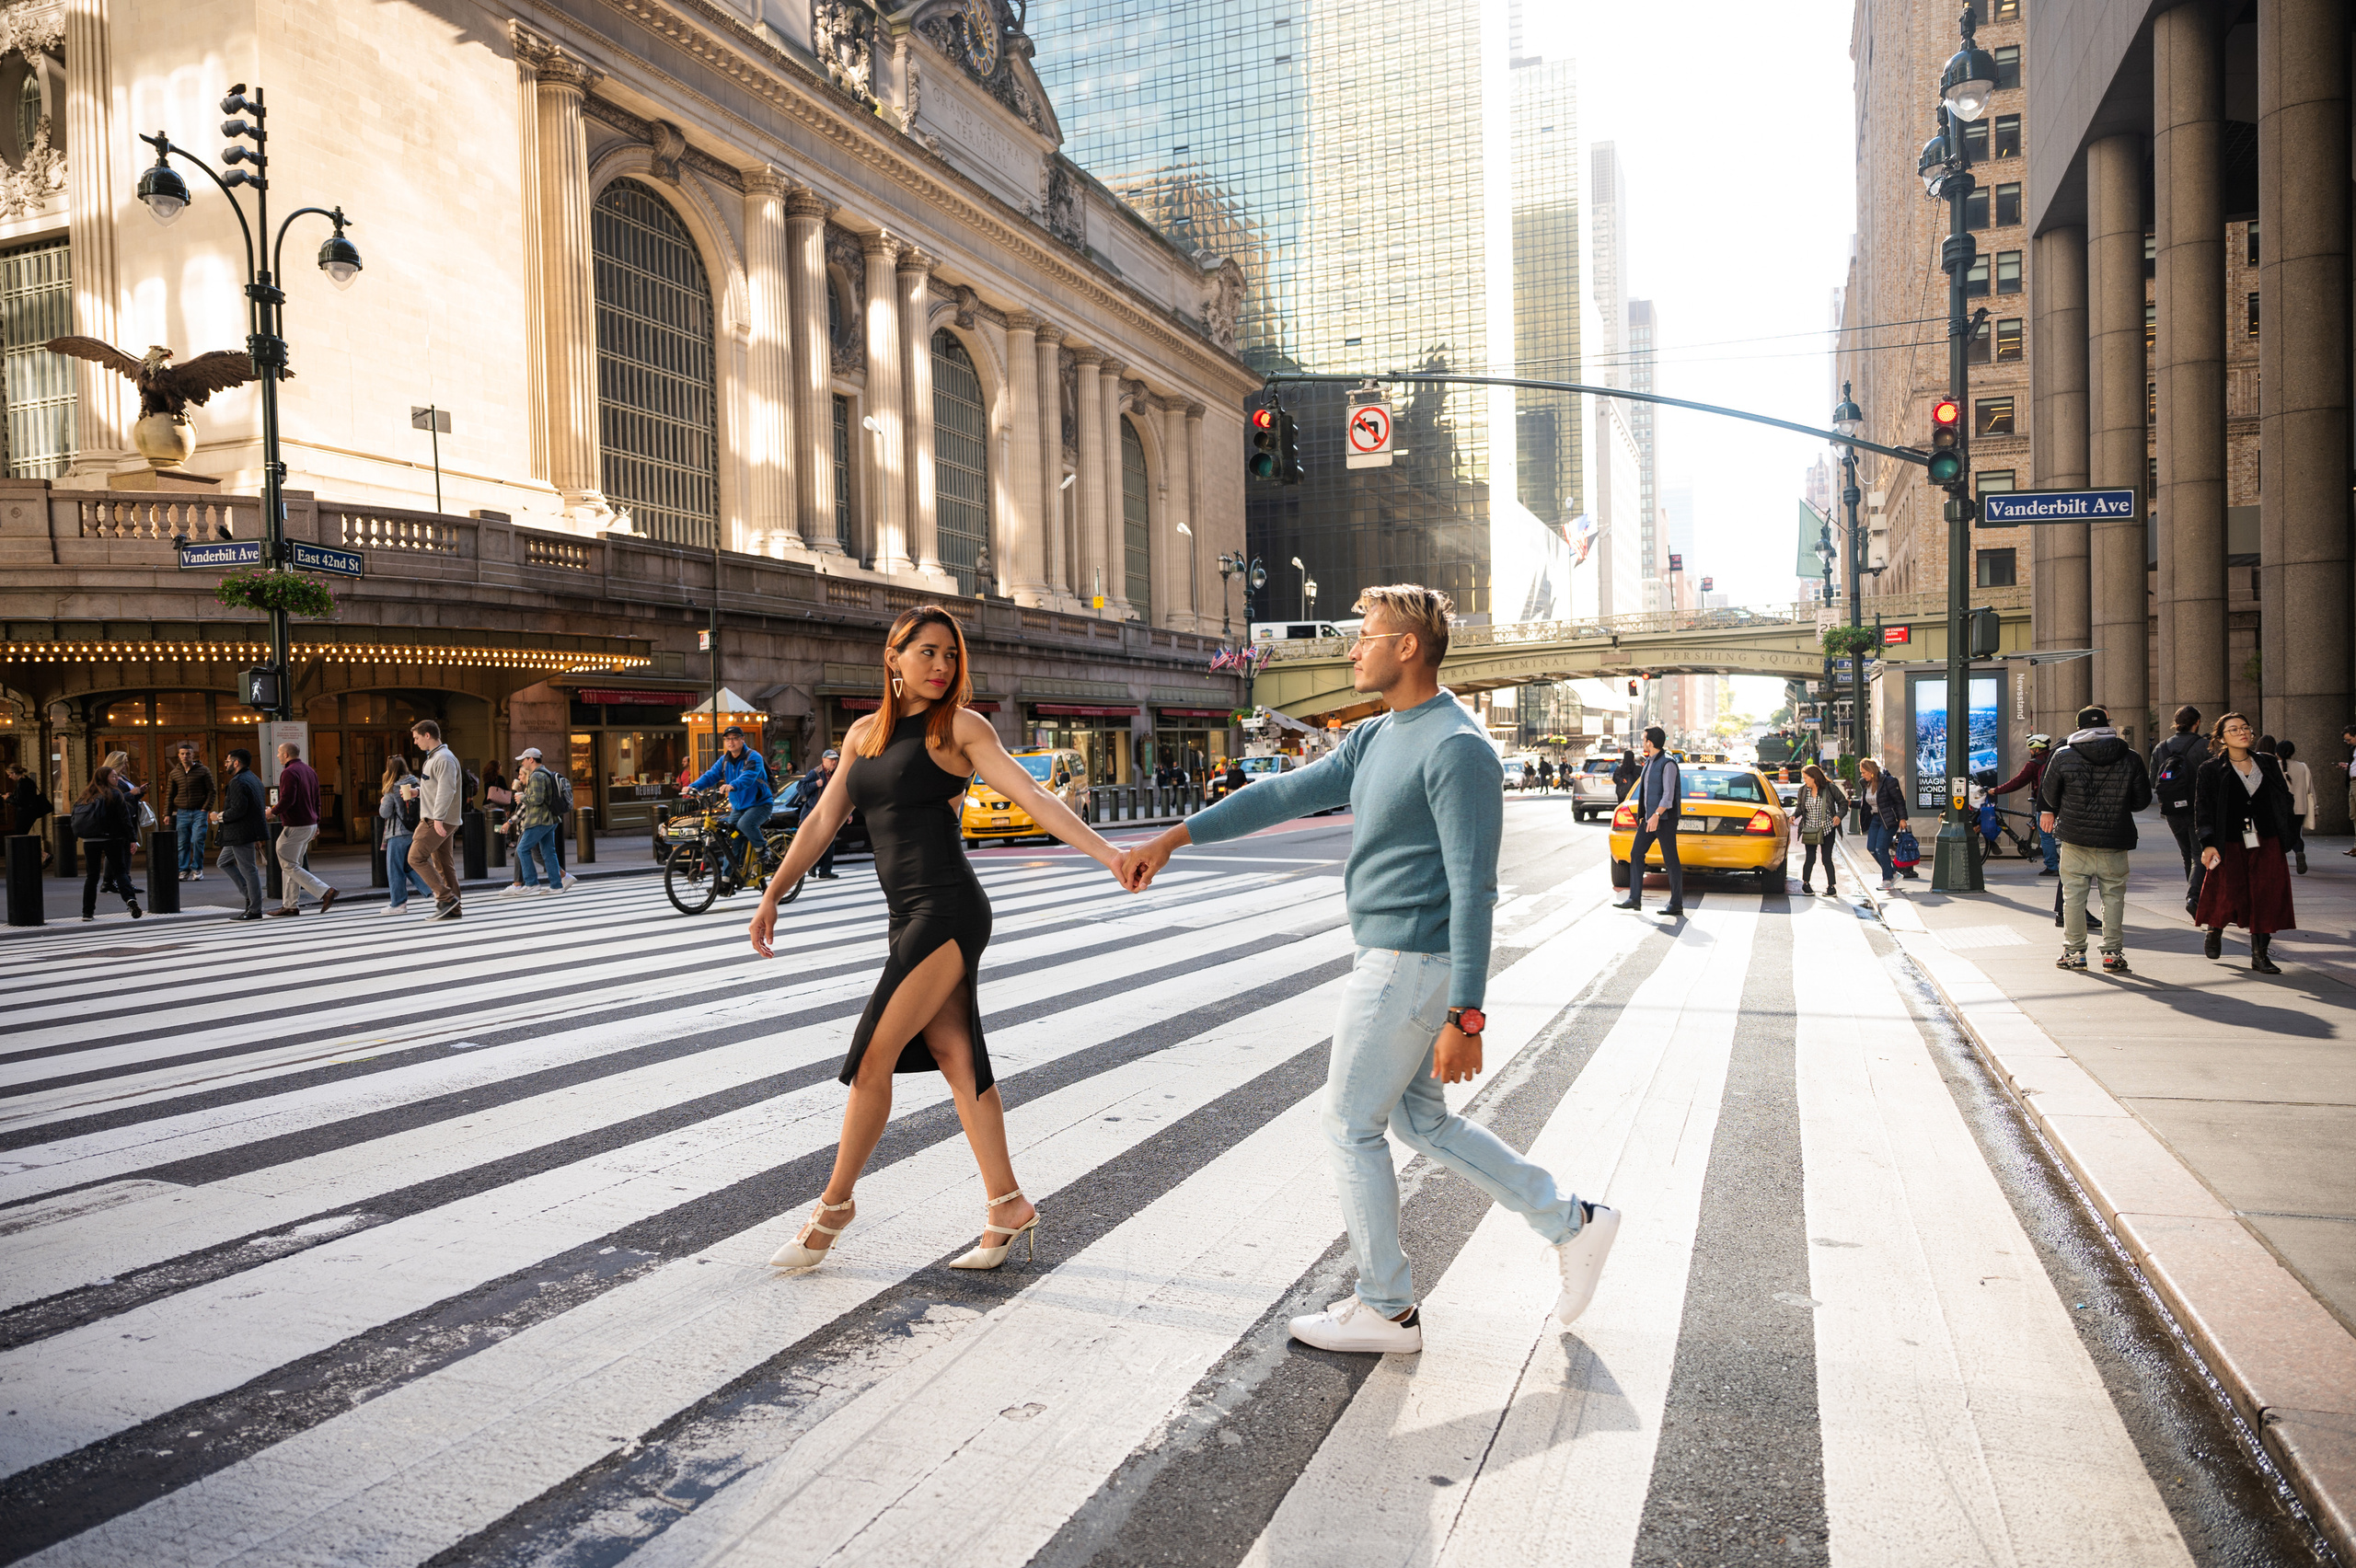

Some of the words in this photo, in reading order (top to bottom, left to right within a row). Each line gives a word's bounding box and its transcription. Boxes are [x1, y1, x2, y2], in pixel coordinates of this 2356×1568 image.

[933, 87, 973, 126] GRAND
[979, 121, 1026, 167] CENTRAL
[955, 120, 1008, 169] TERMINAL
[1990, 499, 2087, 516] Vanderbilt
[2093, 498, 2129, 513] Ave
[182, 549, 236, 564] Vanderbilt
[238, 547, 259, 560] Ave
[296, 548, 320, 564] East
[322, 553, 346, 570] 42nd
[349, 558, 359, 571] St
[1489, 658, 1569, 672] TERMINAL
[1663, 651, 1748, 662] PERSHING
[2016, 673, 2026, 721] Newsstand
[1699, 755, 1715, 763] 2H85
[635, 784, 662, 796] NEUHAUS
[1919, 785, 1946, 793] WONDE
